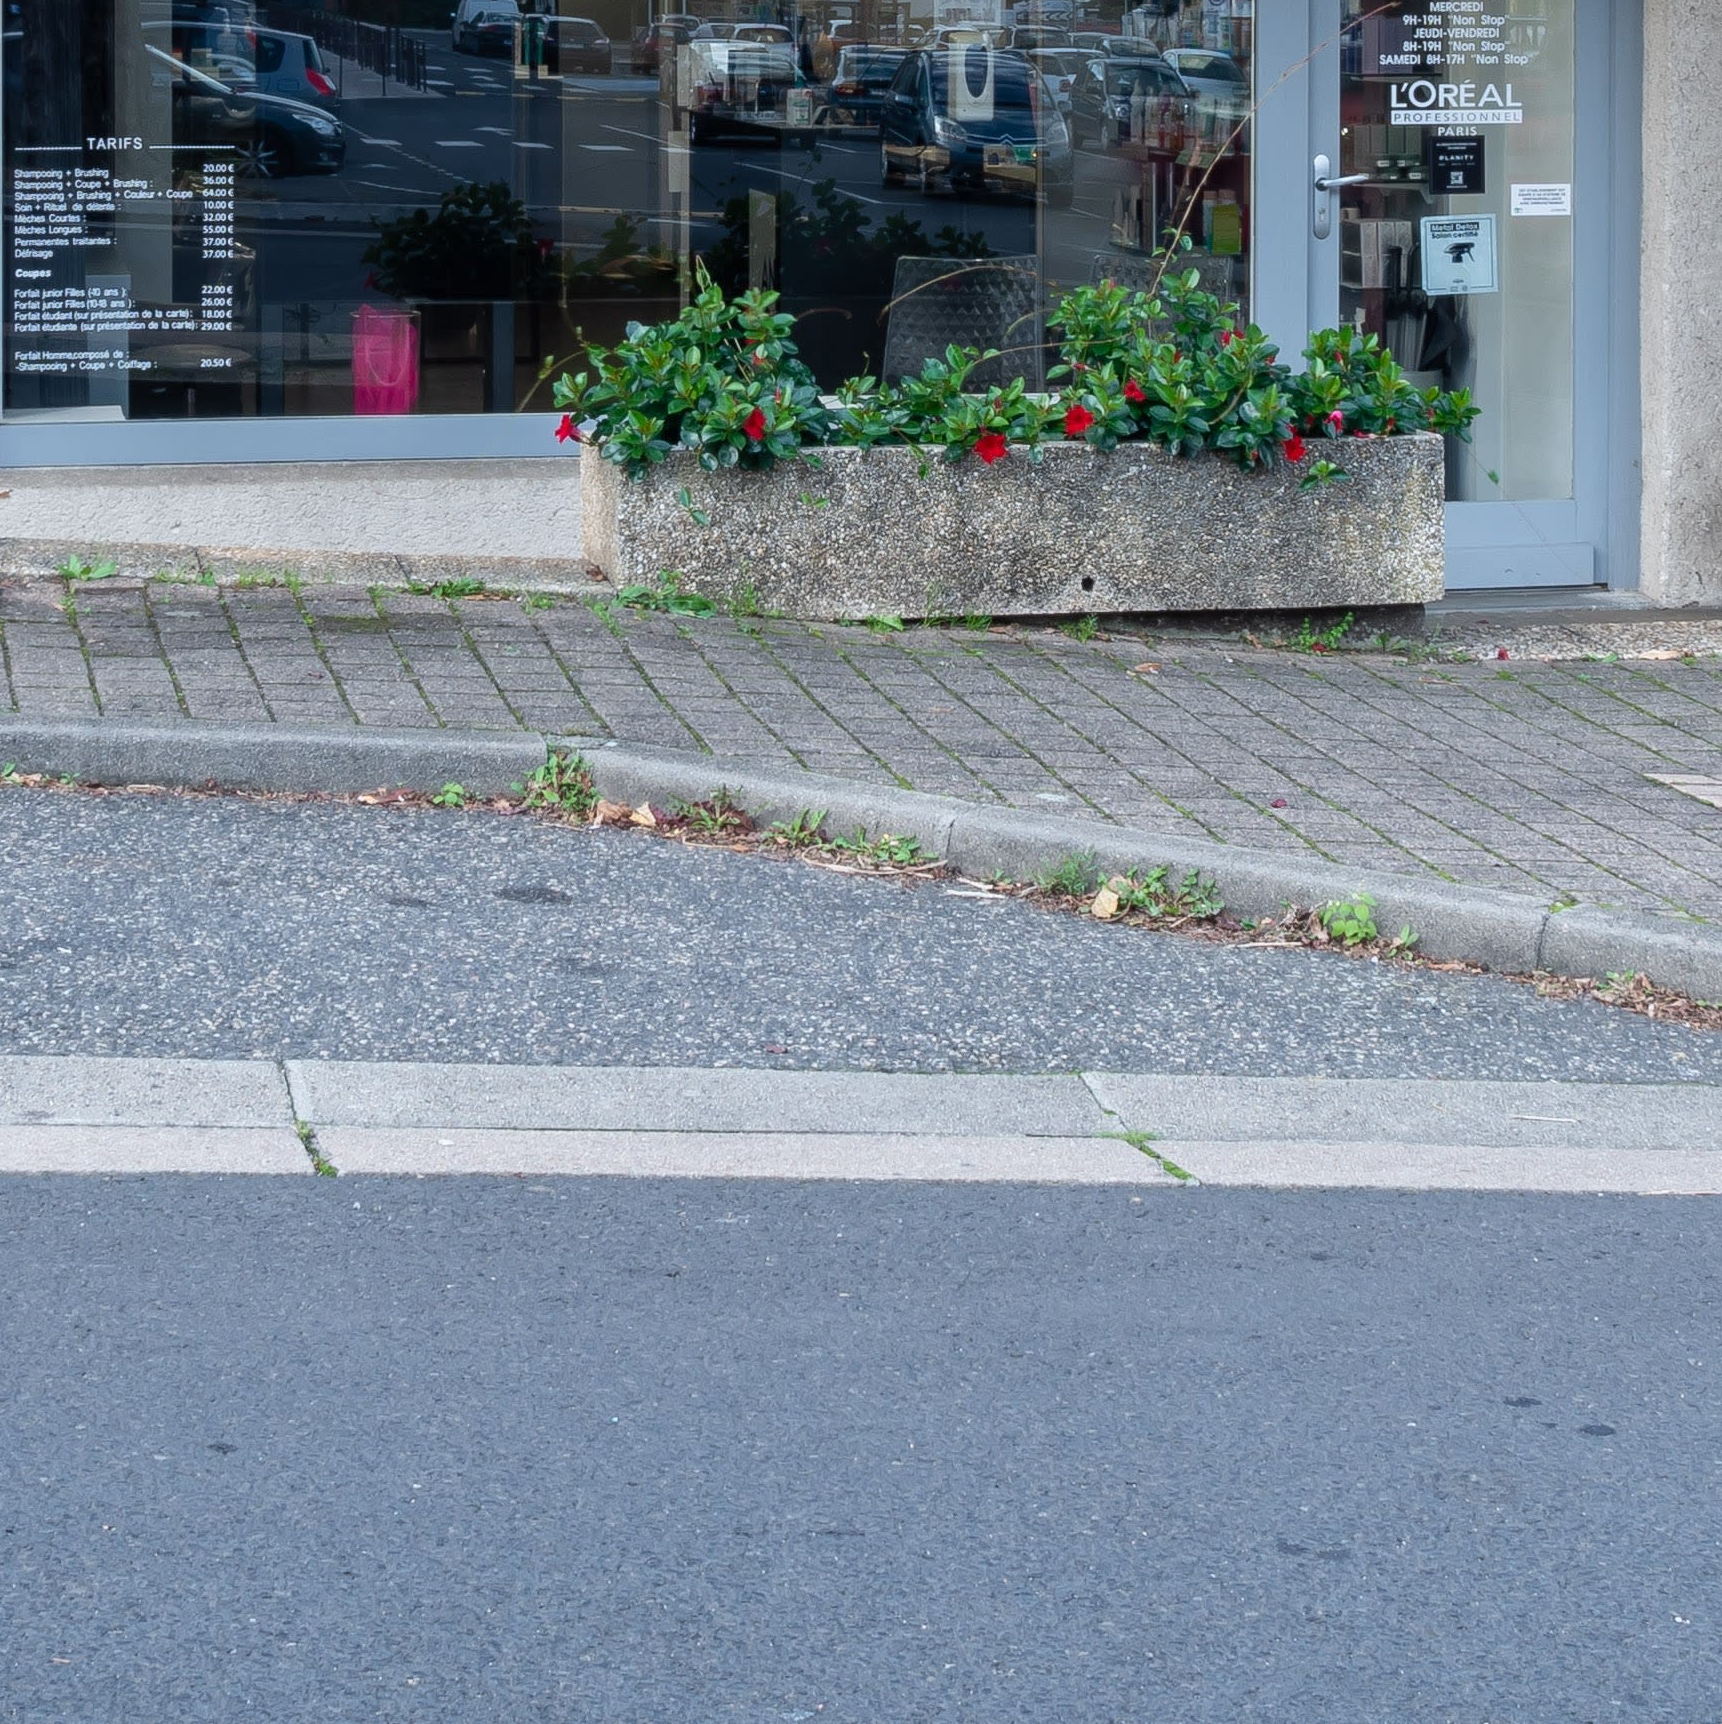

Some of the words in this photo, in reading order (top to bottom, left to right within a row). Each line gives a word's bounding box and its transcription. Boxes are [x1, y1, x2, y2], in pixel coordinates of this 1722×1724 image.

[1429, 2, 1483, 12] MERCREDI
[1402, 15, 1442, 25] 9H-19H
[1413, 28, 1499, 38] JEUDI-VENDREDI
[1403, 41, 1442, 51] 8H-19H
[1379, 55, 1420, 65] SAMEDI
[1426, 54, 1465, 64] 8H-17H
[1391, 80, 1522, 108] L'ORÉAL
[1394, 113, 1520, 122] PROFESSIONNEL
[1437, 126, 1477, 136] PARIS
[87, 137, 143, 150] TARIFS
[14, 169, 63, 179] Shampooing
[75, 168, 109, 179] Brushing
[203, 164, 226, 173] 20.00
[14, 180, 63, 191] Shampooing
[75, 180, 101, 189] Coupe
[113, 179, 148, 189] Brushing
[203, 176, 226, 185] 36.00
[14, 192, 64, 202] Shampooing
[76, 191, 112, 201] Brushing
[124, 190, 155, 199] Couleur
[166, 190, 193, 199] Coupe
[203, 188, 226, 197] 64.00
[203, 201, 226, 210] 10.00
[203, 213, 226, 222] 32.00
[203, 225, 226, 234] 55.00
[202, 237, 226, 246] 37.00
[14, 249, 53, 259] Défrisage
[202, 249, 226, 259] 37.00
[15, 269, 51, 280] Coupes
[14, 289, 40, 298] Forfait
[42, 289, 63, 300] junior
[65, 288, 85, 297] Filles
[104, 289, 119, 297] ans
[201, 285, 224, 294] 22.00
[14, 300, 40, 310] Forfait
[42, 300, 63, 311] junior
[65, 299, 85, 309] Filles
[110, 300, 125, 308] ans
[201, 298, 224, 307] 26.00
[201, 310, 224, 319] 18.00
[201, 322, 224, 331] 29.00
[79, 360, 105, 370] Coupe
[118, 359, 152, 370] Coiffage
[200, 358, 224, 368] 20.50
